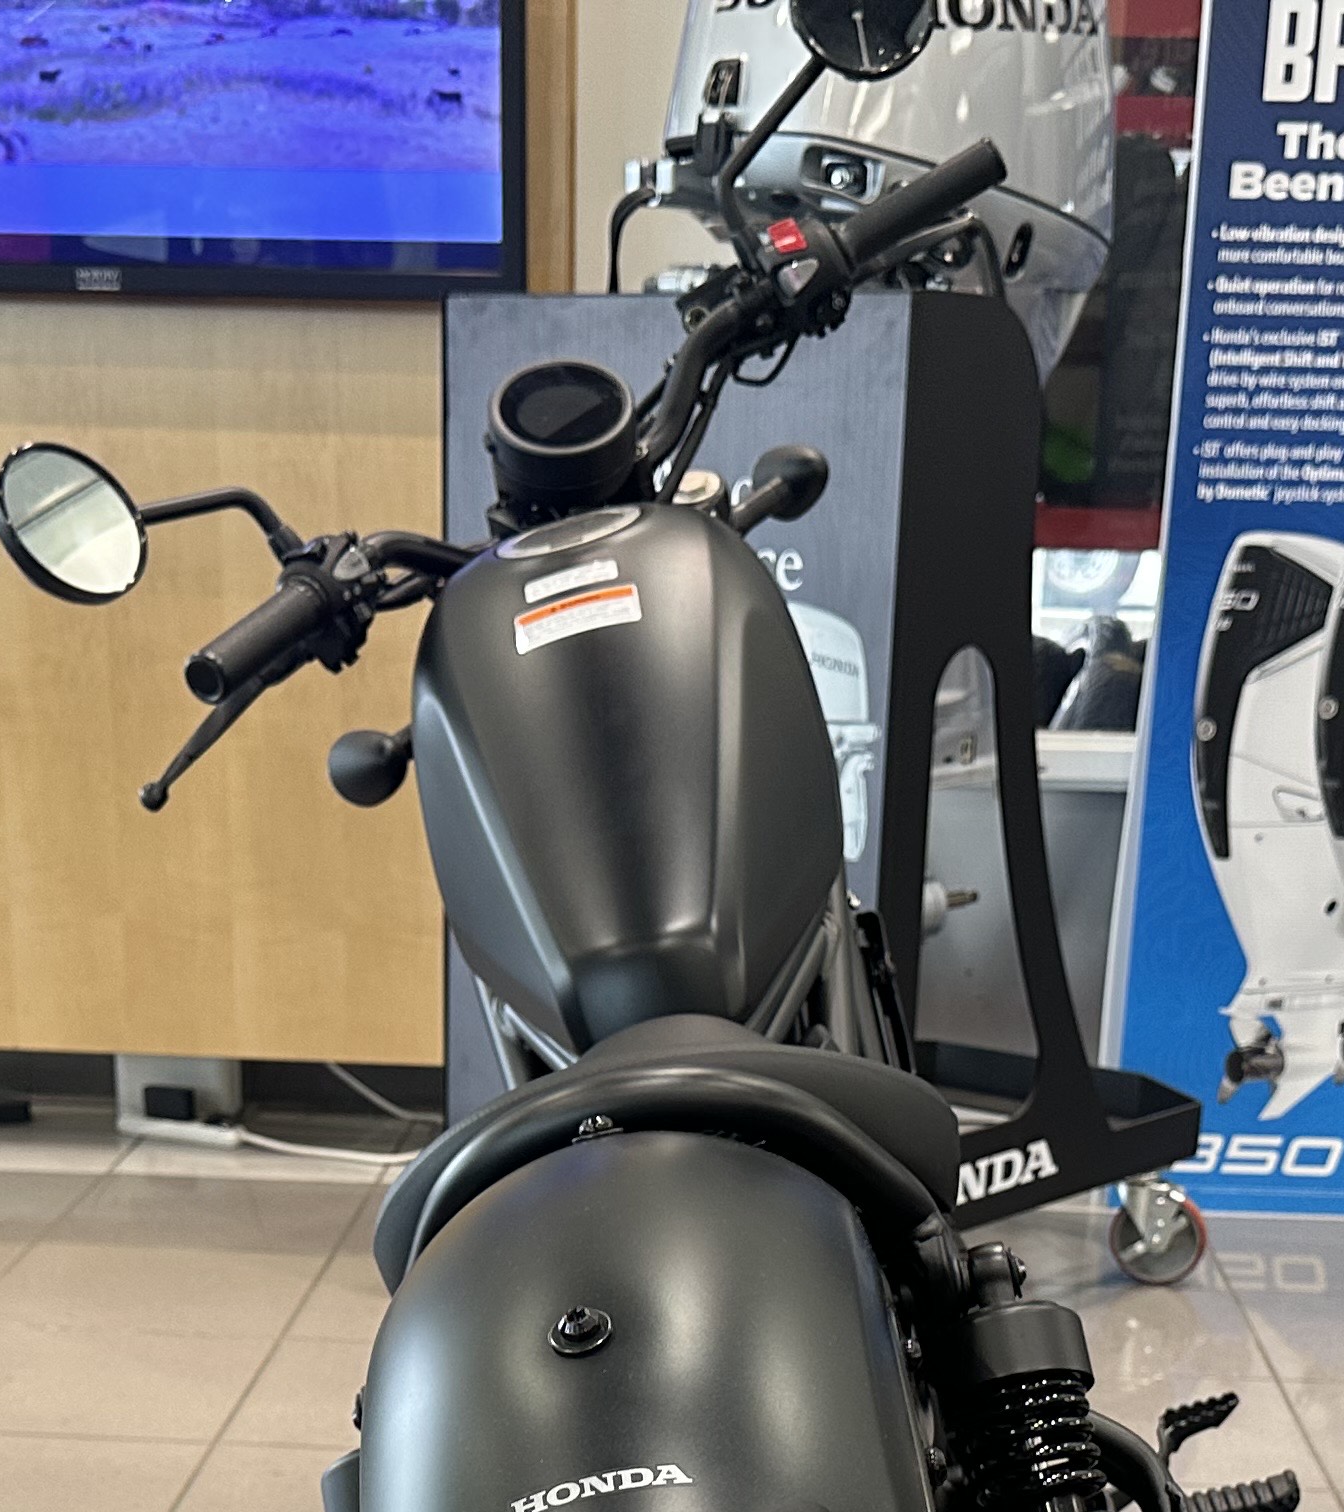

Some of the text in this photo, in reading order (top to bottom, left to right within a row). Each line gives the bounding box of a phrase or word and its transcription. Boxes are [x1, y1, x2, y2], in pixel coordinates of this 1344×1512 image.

[1218, 247, 1250, 263] more
[1251, 247, 1323, 265] comfortable
[1252, 274, 1315, 297] operation
